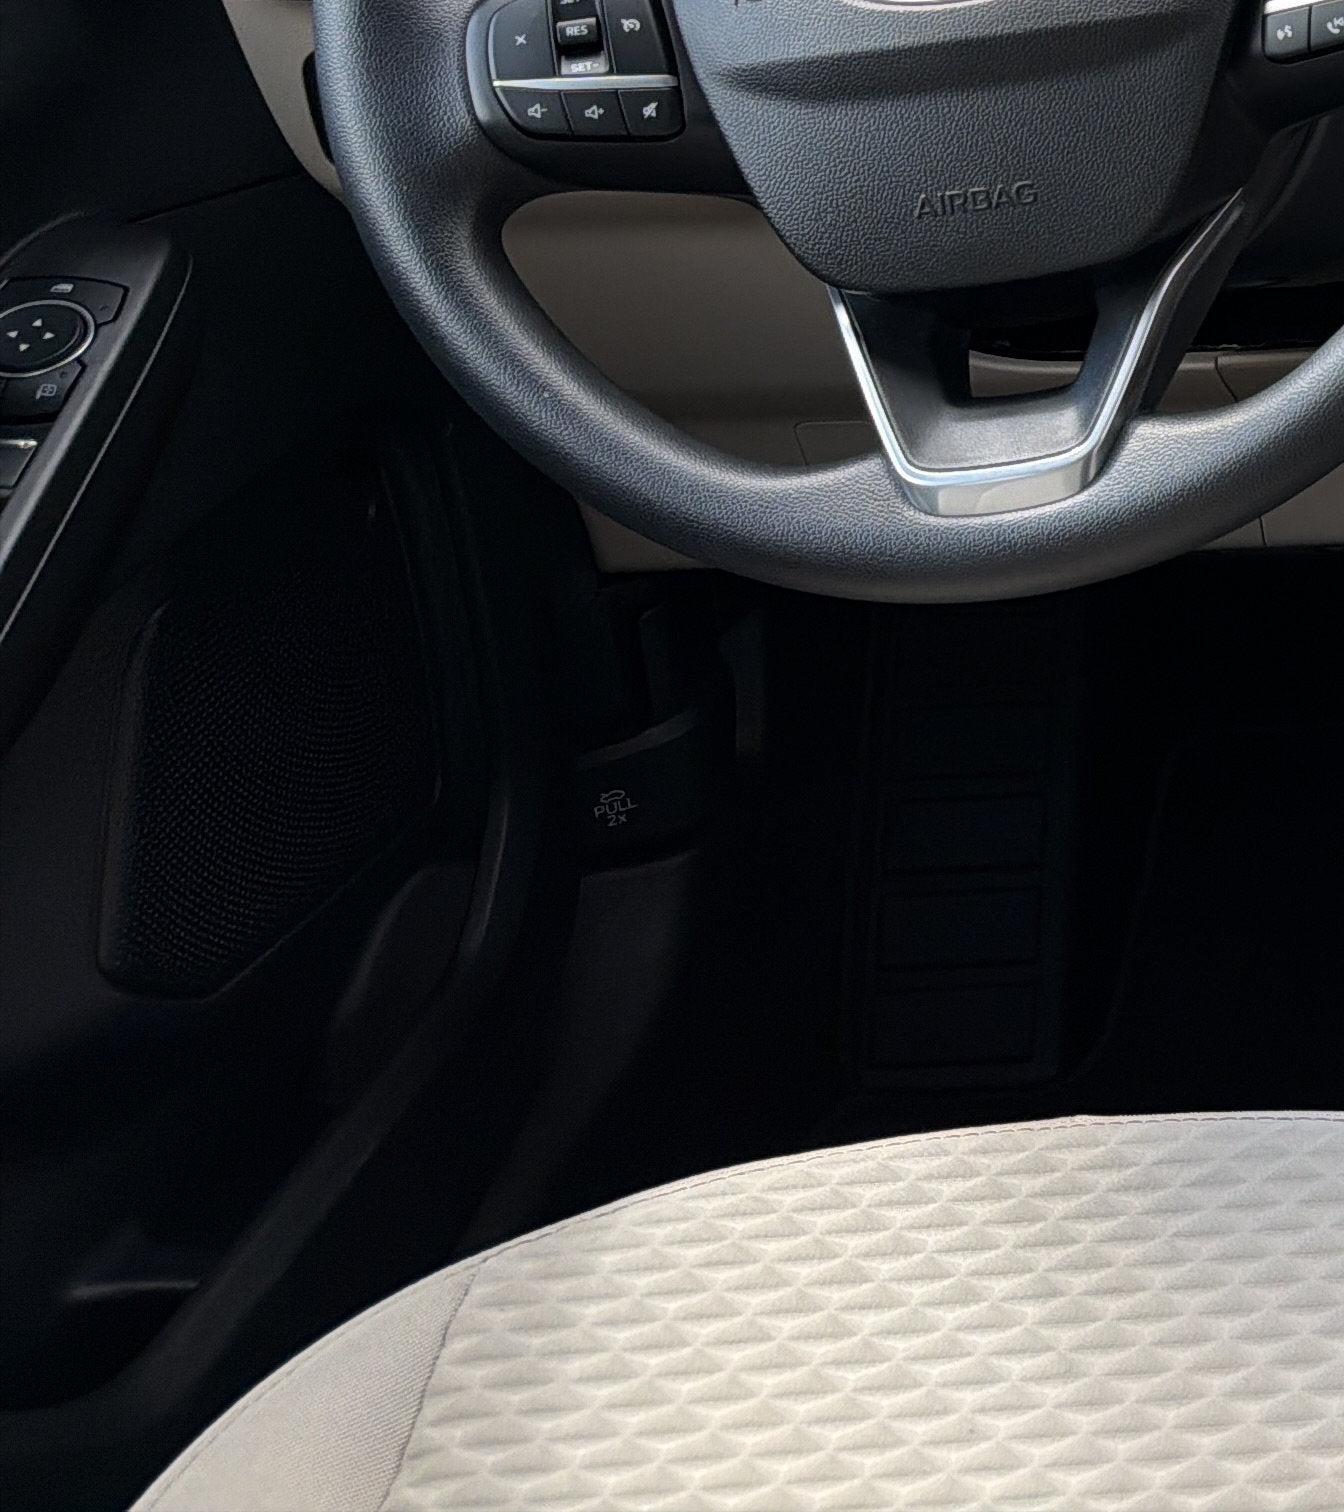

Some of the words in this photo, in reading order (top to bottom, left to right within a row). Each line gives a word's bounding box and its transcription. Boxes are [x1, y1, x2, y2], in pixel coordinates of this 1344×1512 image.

[565, 24, 589, 37] RES
[913, 180, 1041, 218] AIRBAG
[593, 796, 640, 819] PULL
